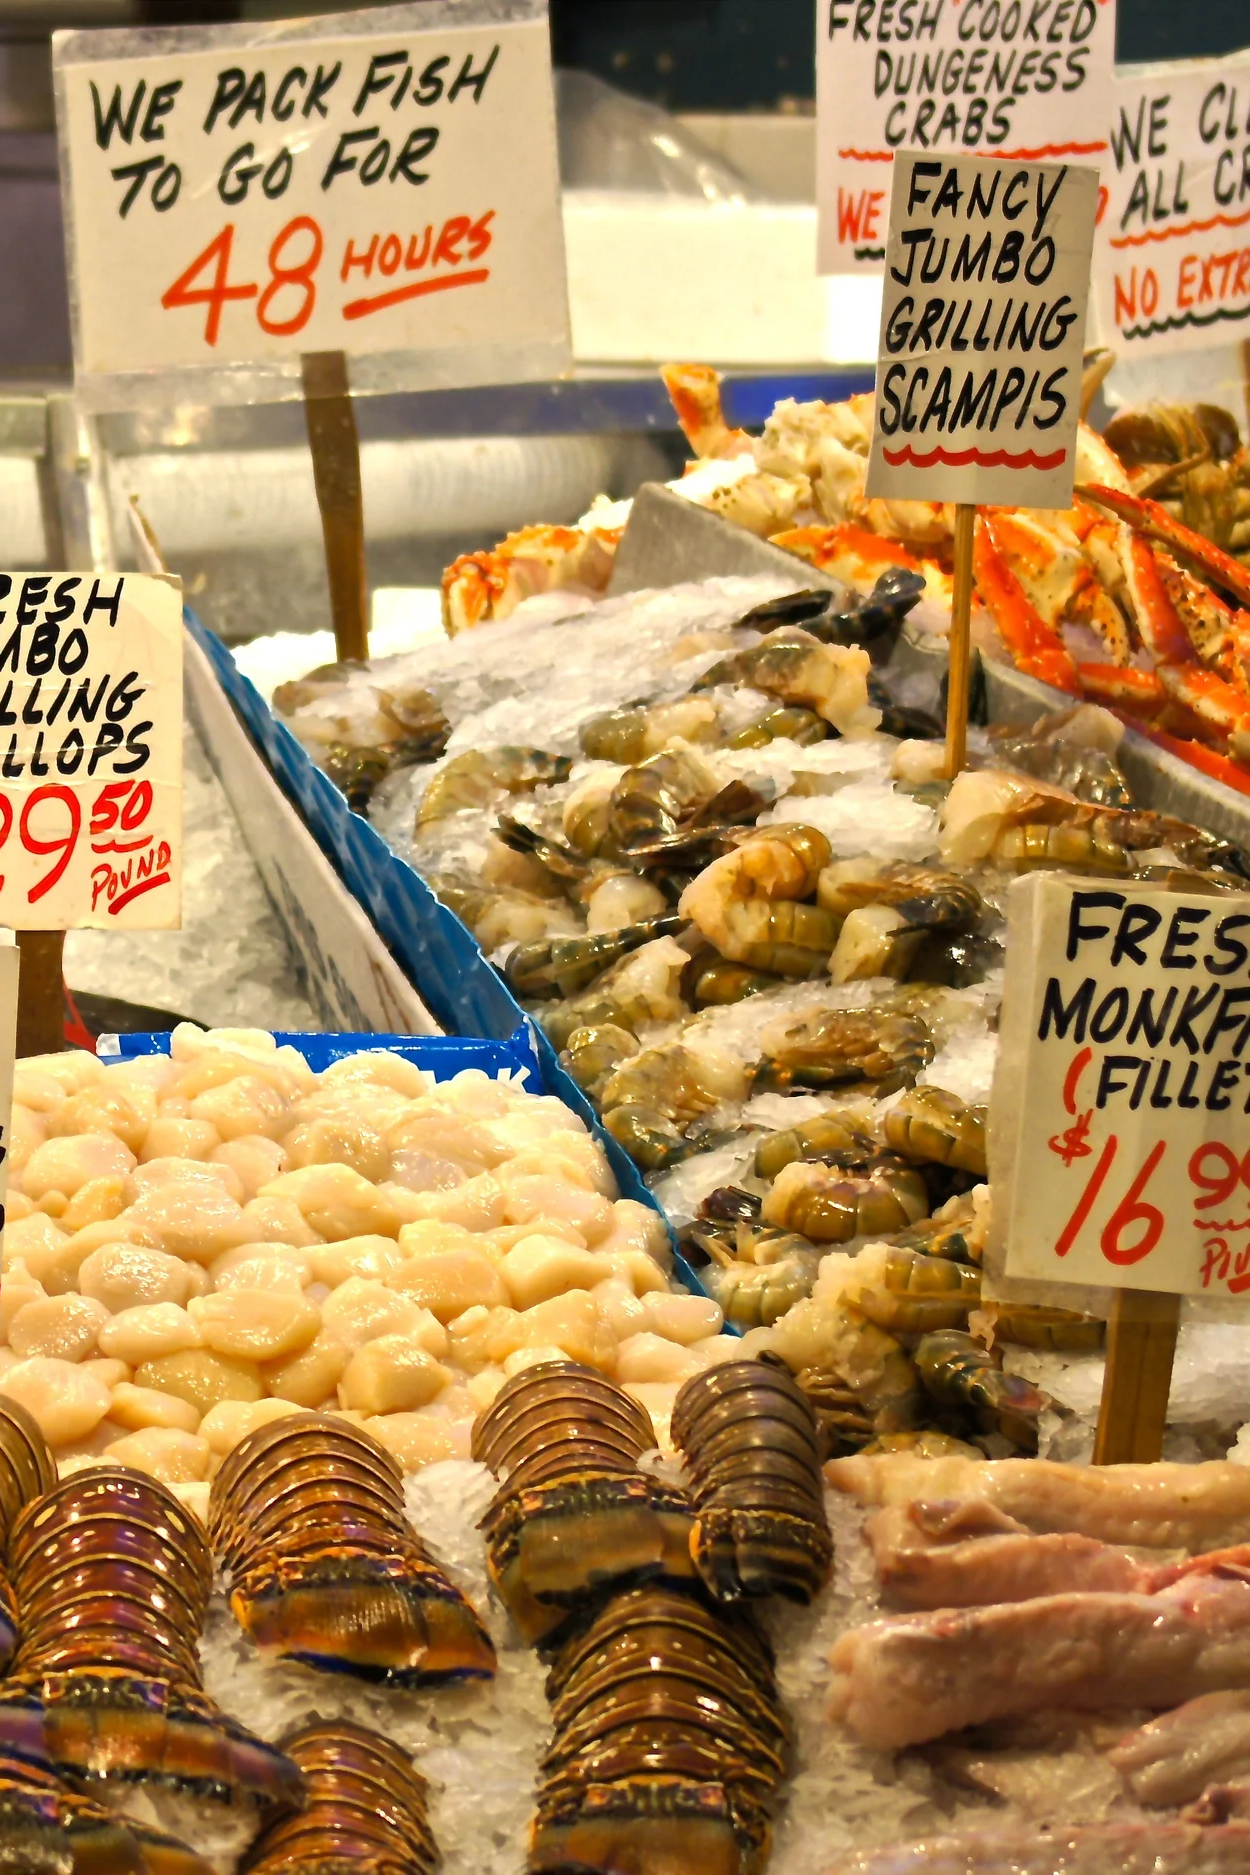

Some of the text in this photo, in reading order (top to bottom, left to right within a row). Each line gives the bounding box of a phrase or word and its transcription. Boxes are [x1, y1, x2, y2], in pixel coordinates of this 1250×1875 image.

[828, 0, 1097, 43] FRESH COOKED
[90, 44, 500, 151] WE PACK FISH
[874, 46, 1090, 100] DUNGENESS
[884, 97, 1016, 148] CRABS
[1110, 82, 1250, 173] WE CL
[110, 127, 440, 219] TO GO FOR
[907, 161, 1068, 241] FANCY
[1119, 160, 1189, 231] ALL
[838, 187, 886, 245] WE
[161, 210, 496, 347] 48 HOURS
[890, 228, 1056, 287] JUMBO
[885, 296, 1078, 355] GRILLING
[1114, 266, 1159, 327] NO
[879, 362, 1069, 436] SCAMPIS
[89, 778, 154, 835] 50
[91, 840, 172, 912] POUND
[1066, 891, 1250, 976] FRES
